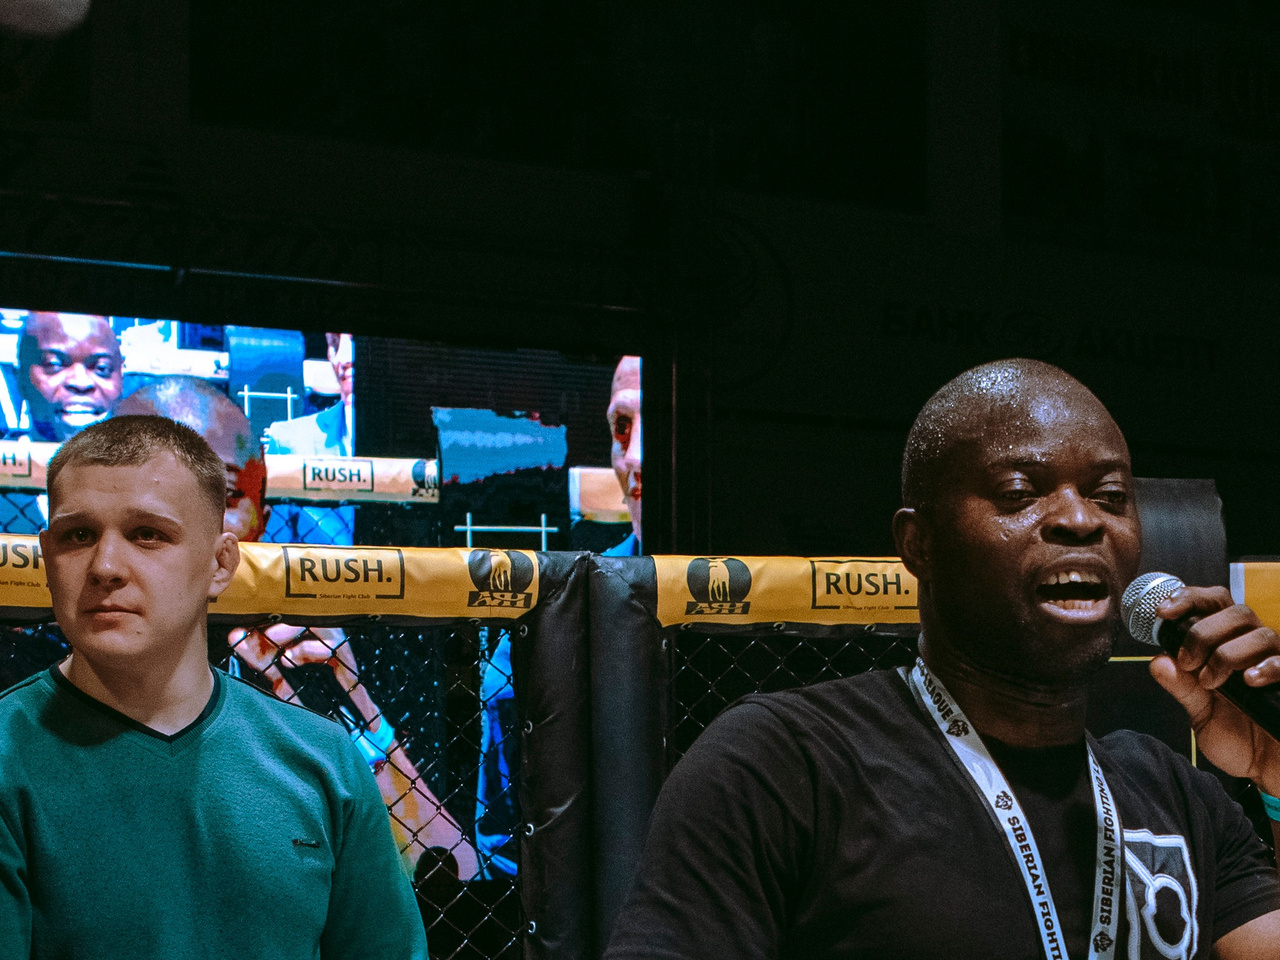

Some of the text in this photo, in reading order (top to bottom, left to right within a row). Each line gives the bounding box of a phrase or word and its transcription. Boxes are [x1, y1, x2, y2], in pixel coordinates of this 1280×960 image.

[311, 466, 367, 484] RUSH.
[300, 558, 393, 583] RUSH.
[825, 573, 910, 596] RUSH.
[1008, 815, 1045, 897] SIBERIAN
[1096, 775, 1116, 926] SIBERIAN FIGHTING
